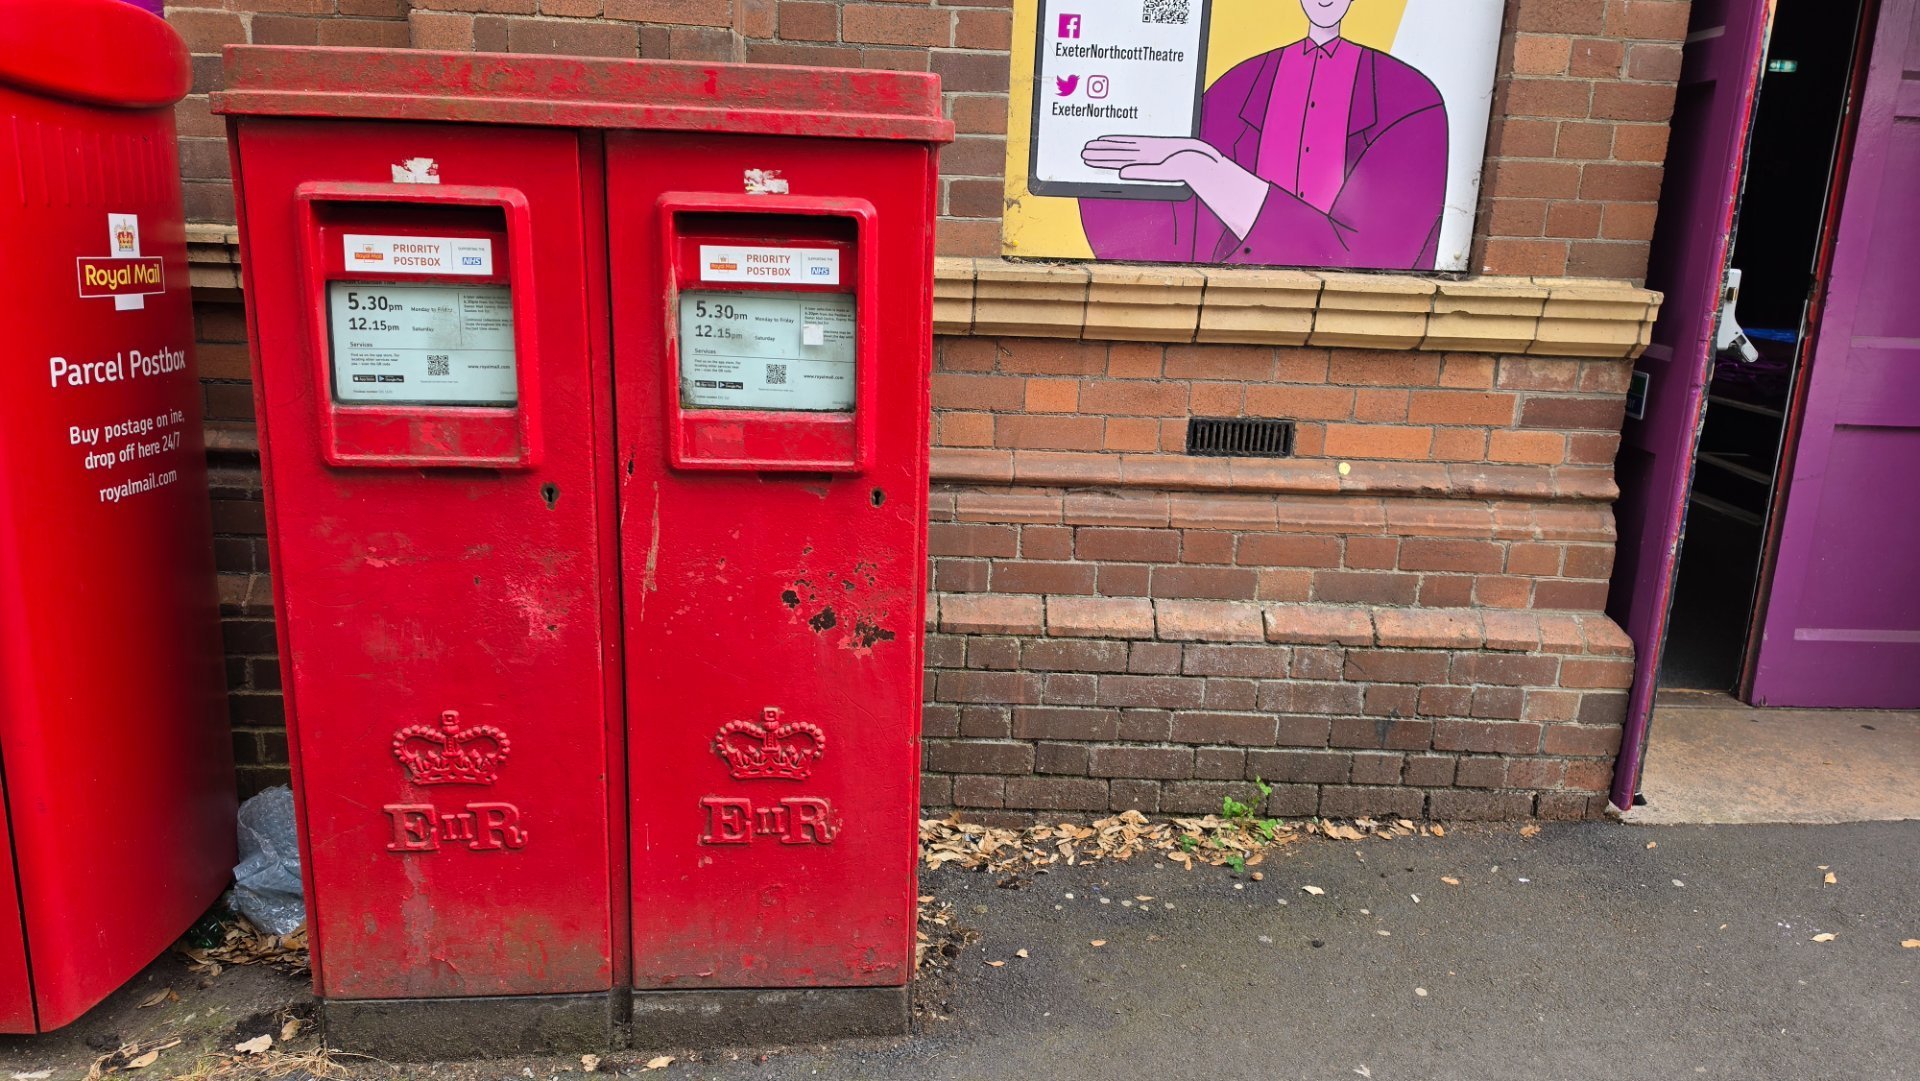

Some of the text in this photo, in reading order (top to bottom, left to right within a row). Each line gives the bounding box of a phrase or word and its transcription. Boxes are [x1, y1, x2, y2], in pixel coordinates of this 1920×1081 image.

[1055, 42, 1184, 62] ExeterNorthcottTheatre
[1052, 101, 1138, 119] ExeterNorthcott
[393, 243, 440, 253] PRIORITY
[393, 256, 441, 266] POSTBOX
[463, 257, 481, 265] NHS
[746, 253, 791, 263] PRIORITY
[85, 263, 160, 290] Royal Mail
[746, 266, 791, 276] POSTBOX
[811, 267, 829, 275] NHS
[50, 346, 186, 388] Parcel Postbox
[69, 426, 99, 446] Buy
[104, 418, 153, 443] postage
[84, 431, 180, 470] drop off here 24/7
[100, 469, 177, 503] royalmail.com
